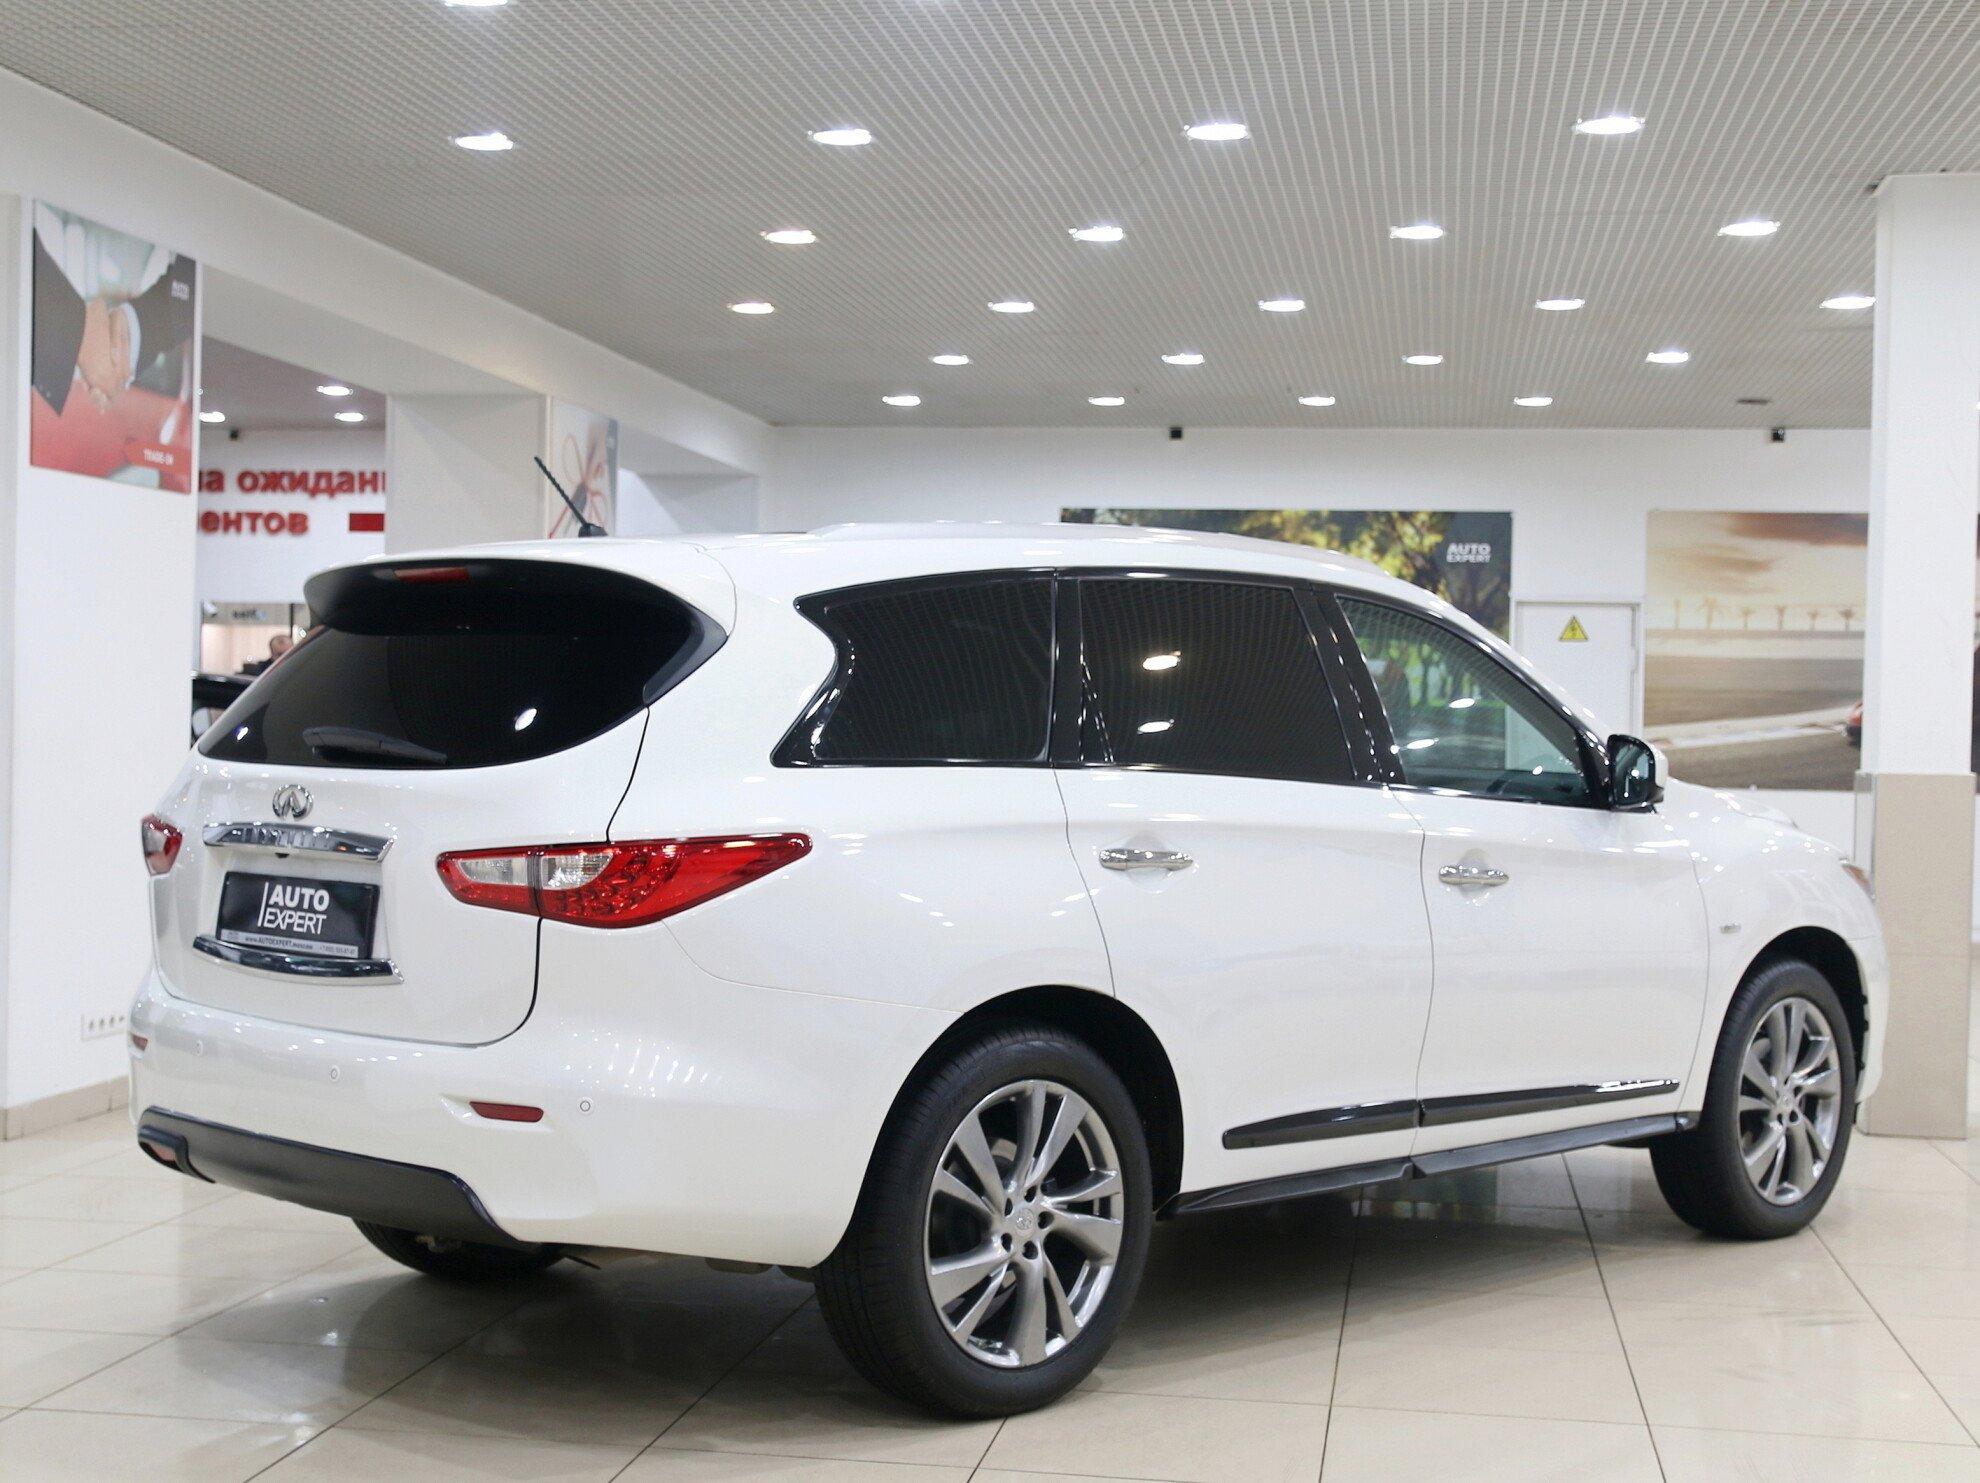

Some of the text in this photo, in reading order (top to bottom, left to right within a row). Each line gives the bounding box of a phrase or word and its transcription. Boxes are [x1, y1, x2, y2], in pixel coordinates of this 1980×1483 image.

[198, 511, 309, 534] ентов
[1446, 554, 1491, 563] EXPERT
[1448, 542, 1491, 555] AUTO
[268, 884, 330, 912] AUTO
[263, 908, 327, 935] EXPERT
